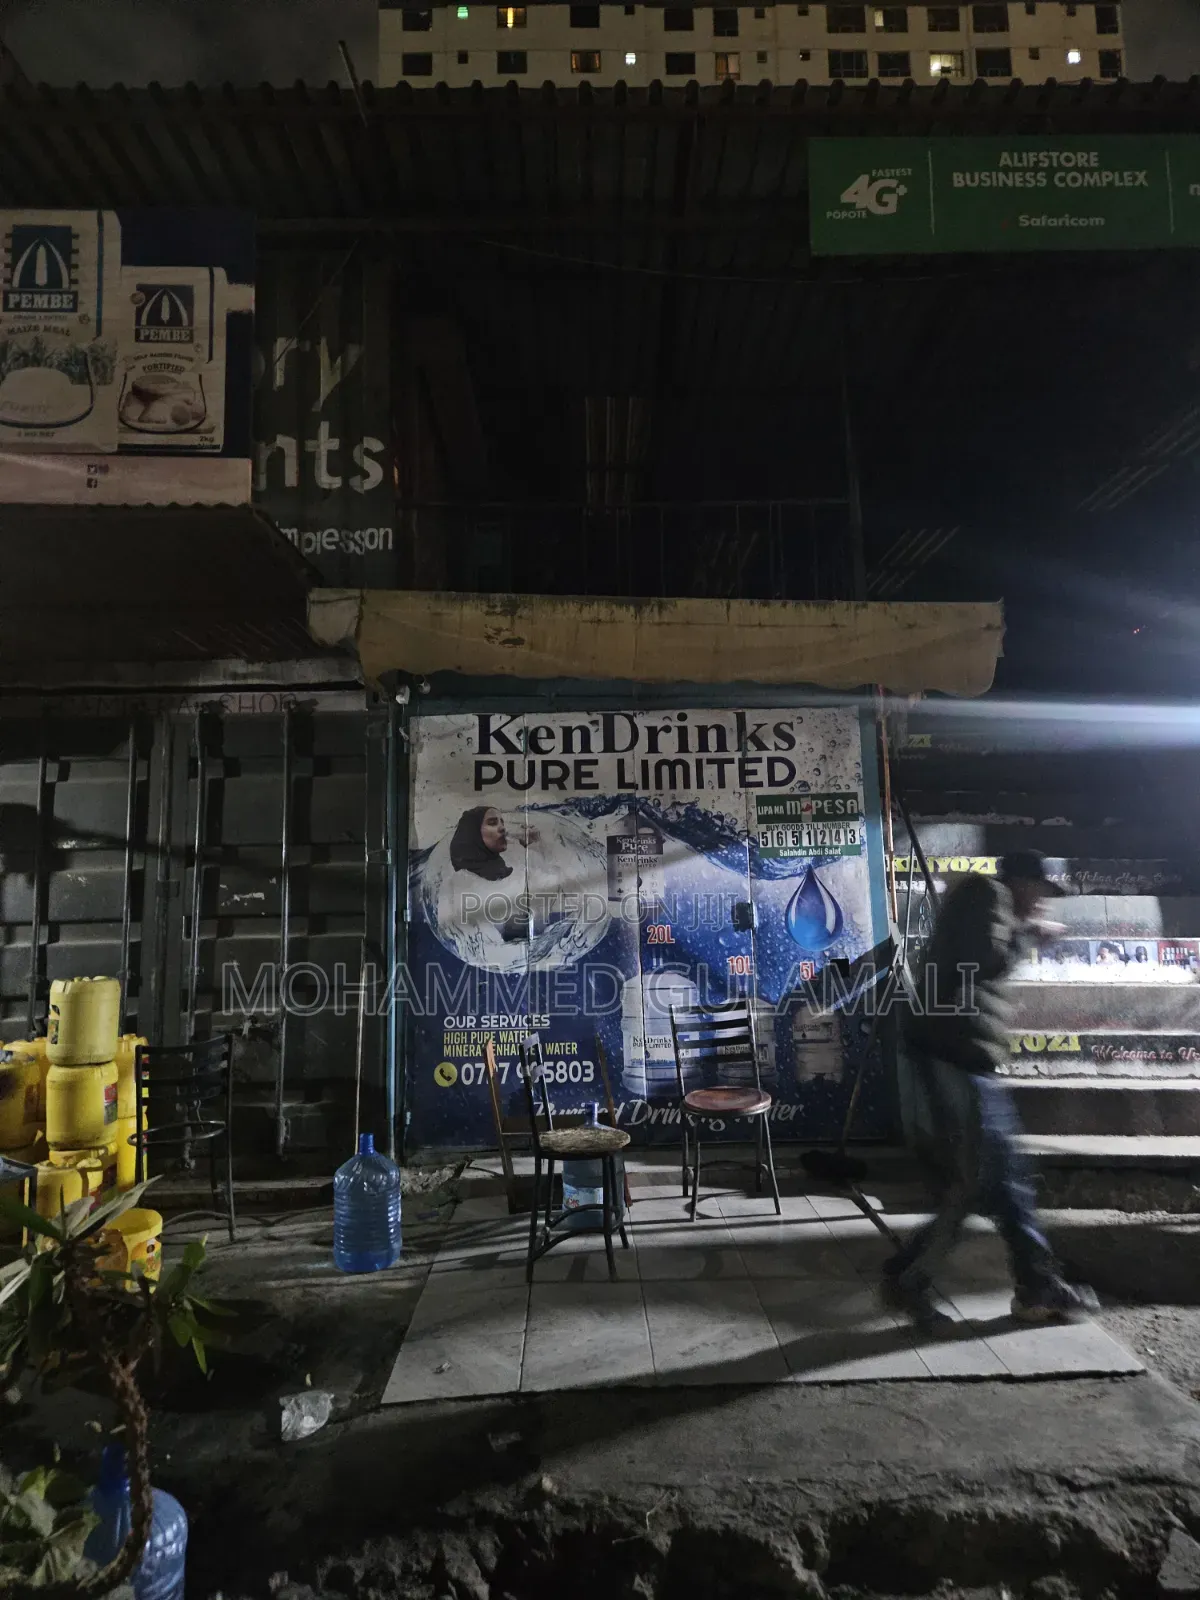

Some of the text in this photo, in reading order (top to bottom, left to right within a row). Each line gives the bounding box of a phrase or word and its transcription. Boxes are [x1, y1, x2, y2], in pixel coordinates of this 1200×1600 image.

[999, 151, 1099, 168] ALIFSTORE
[871, 168, 912, 177] FASTEST
[952, 171, 1148, 188] BUSINESS COMPLEX
[826, 209, 867, 219] POPOTE
[1018, 213, 1105, 227] Safaricom
[8, 293, 74, 309] PEMBE
[139, 328, 190, 341] PEMBE
[472, 712, 798, 755] KenDrinks
[474, 757, 798, 791] PURE LIMITED
[757, 806, 773, 816] LIPA
[774, 806, 785, 815] NA
[766, 824, 780, 832] BUY
[781, 823, 805, 831] GOODS
[822, 822, 850, 830] NUMBER
[647, 925, 676, 945] 20L
[726, 956, 752, 976] 10L
[799, 960, 818, 981] 5L
[444, 1014, 551, 1029] OUR SERVICES
[443, 1032, 468, 1044] HIGH
[471, 1031, 497, 1044] PURE
[443, 1044, 485, 1057] MINERA
[545, 1042, 578, 1055] WATER
[461, 1060, 595, 1085] 077 95803
